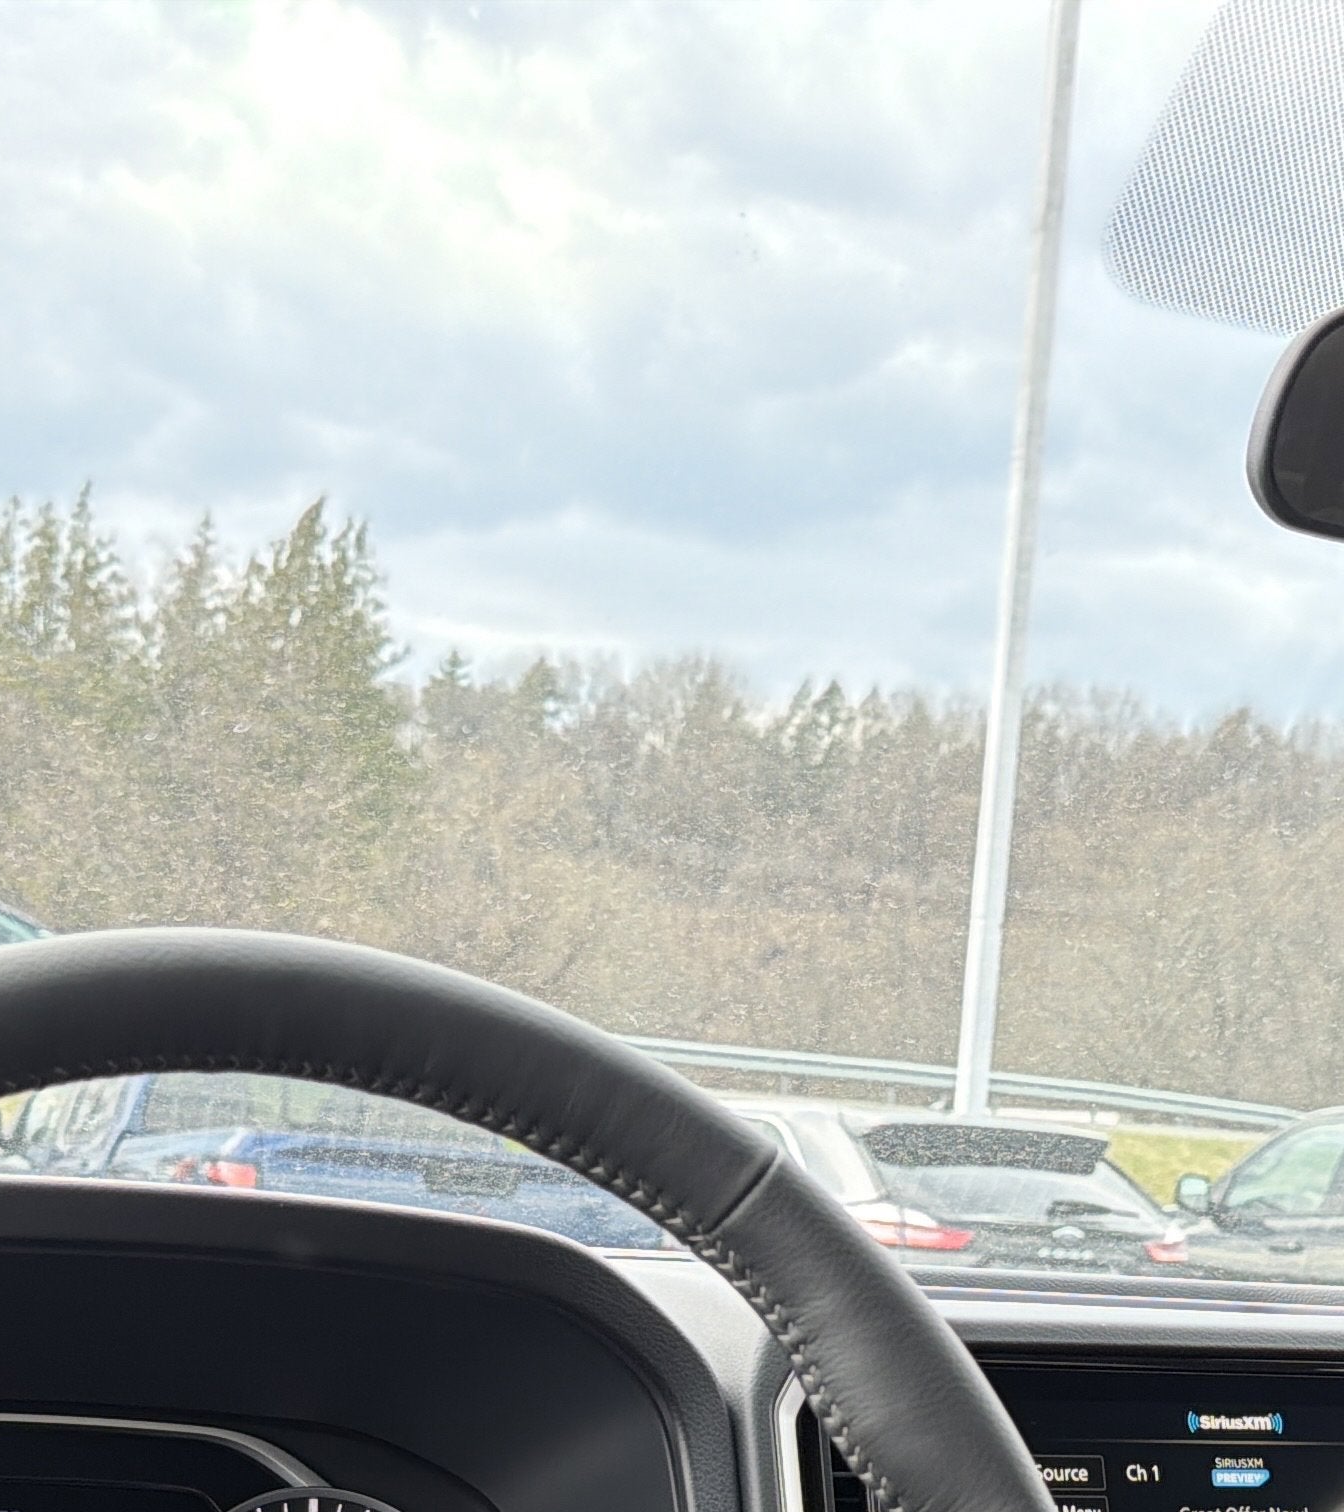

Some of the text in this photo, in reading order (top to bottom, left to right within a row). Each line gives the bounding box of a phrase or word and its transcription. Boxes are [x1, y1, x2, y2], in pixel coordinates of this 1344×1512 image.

[1214, 1457, 1264, 1469] SIRIUSXM
[1126, 1464, 1160, 1482] Ch 1
[1215, 1472, 1262, 1484] PREVIEW
